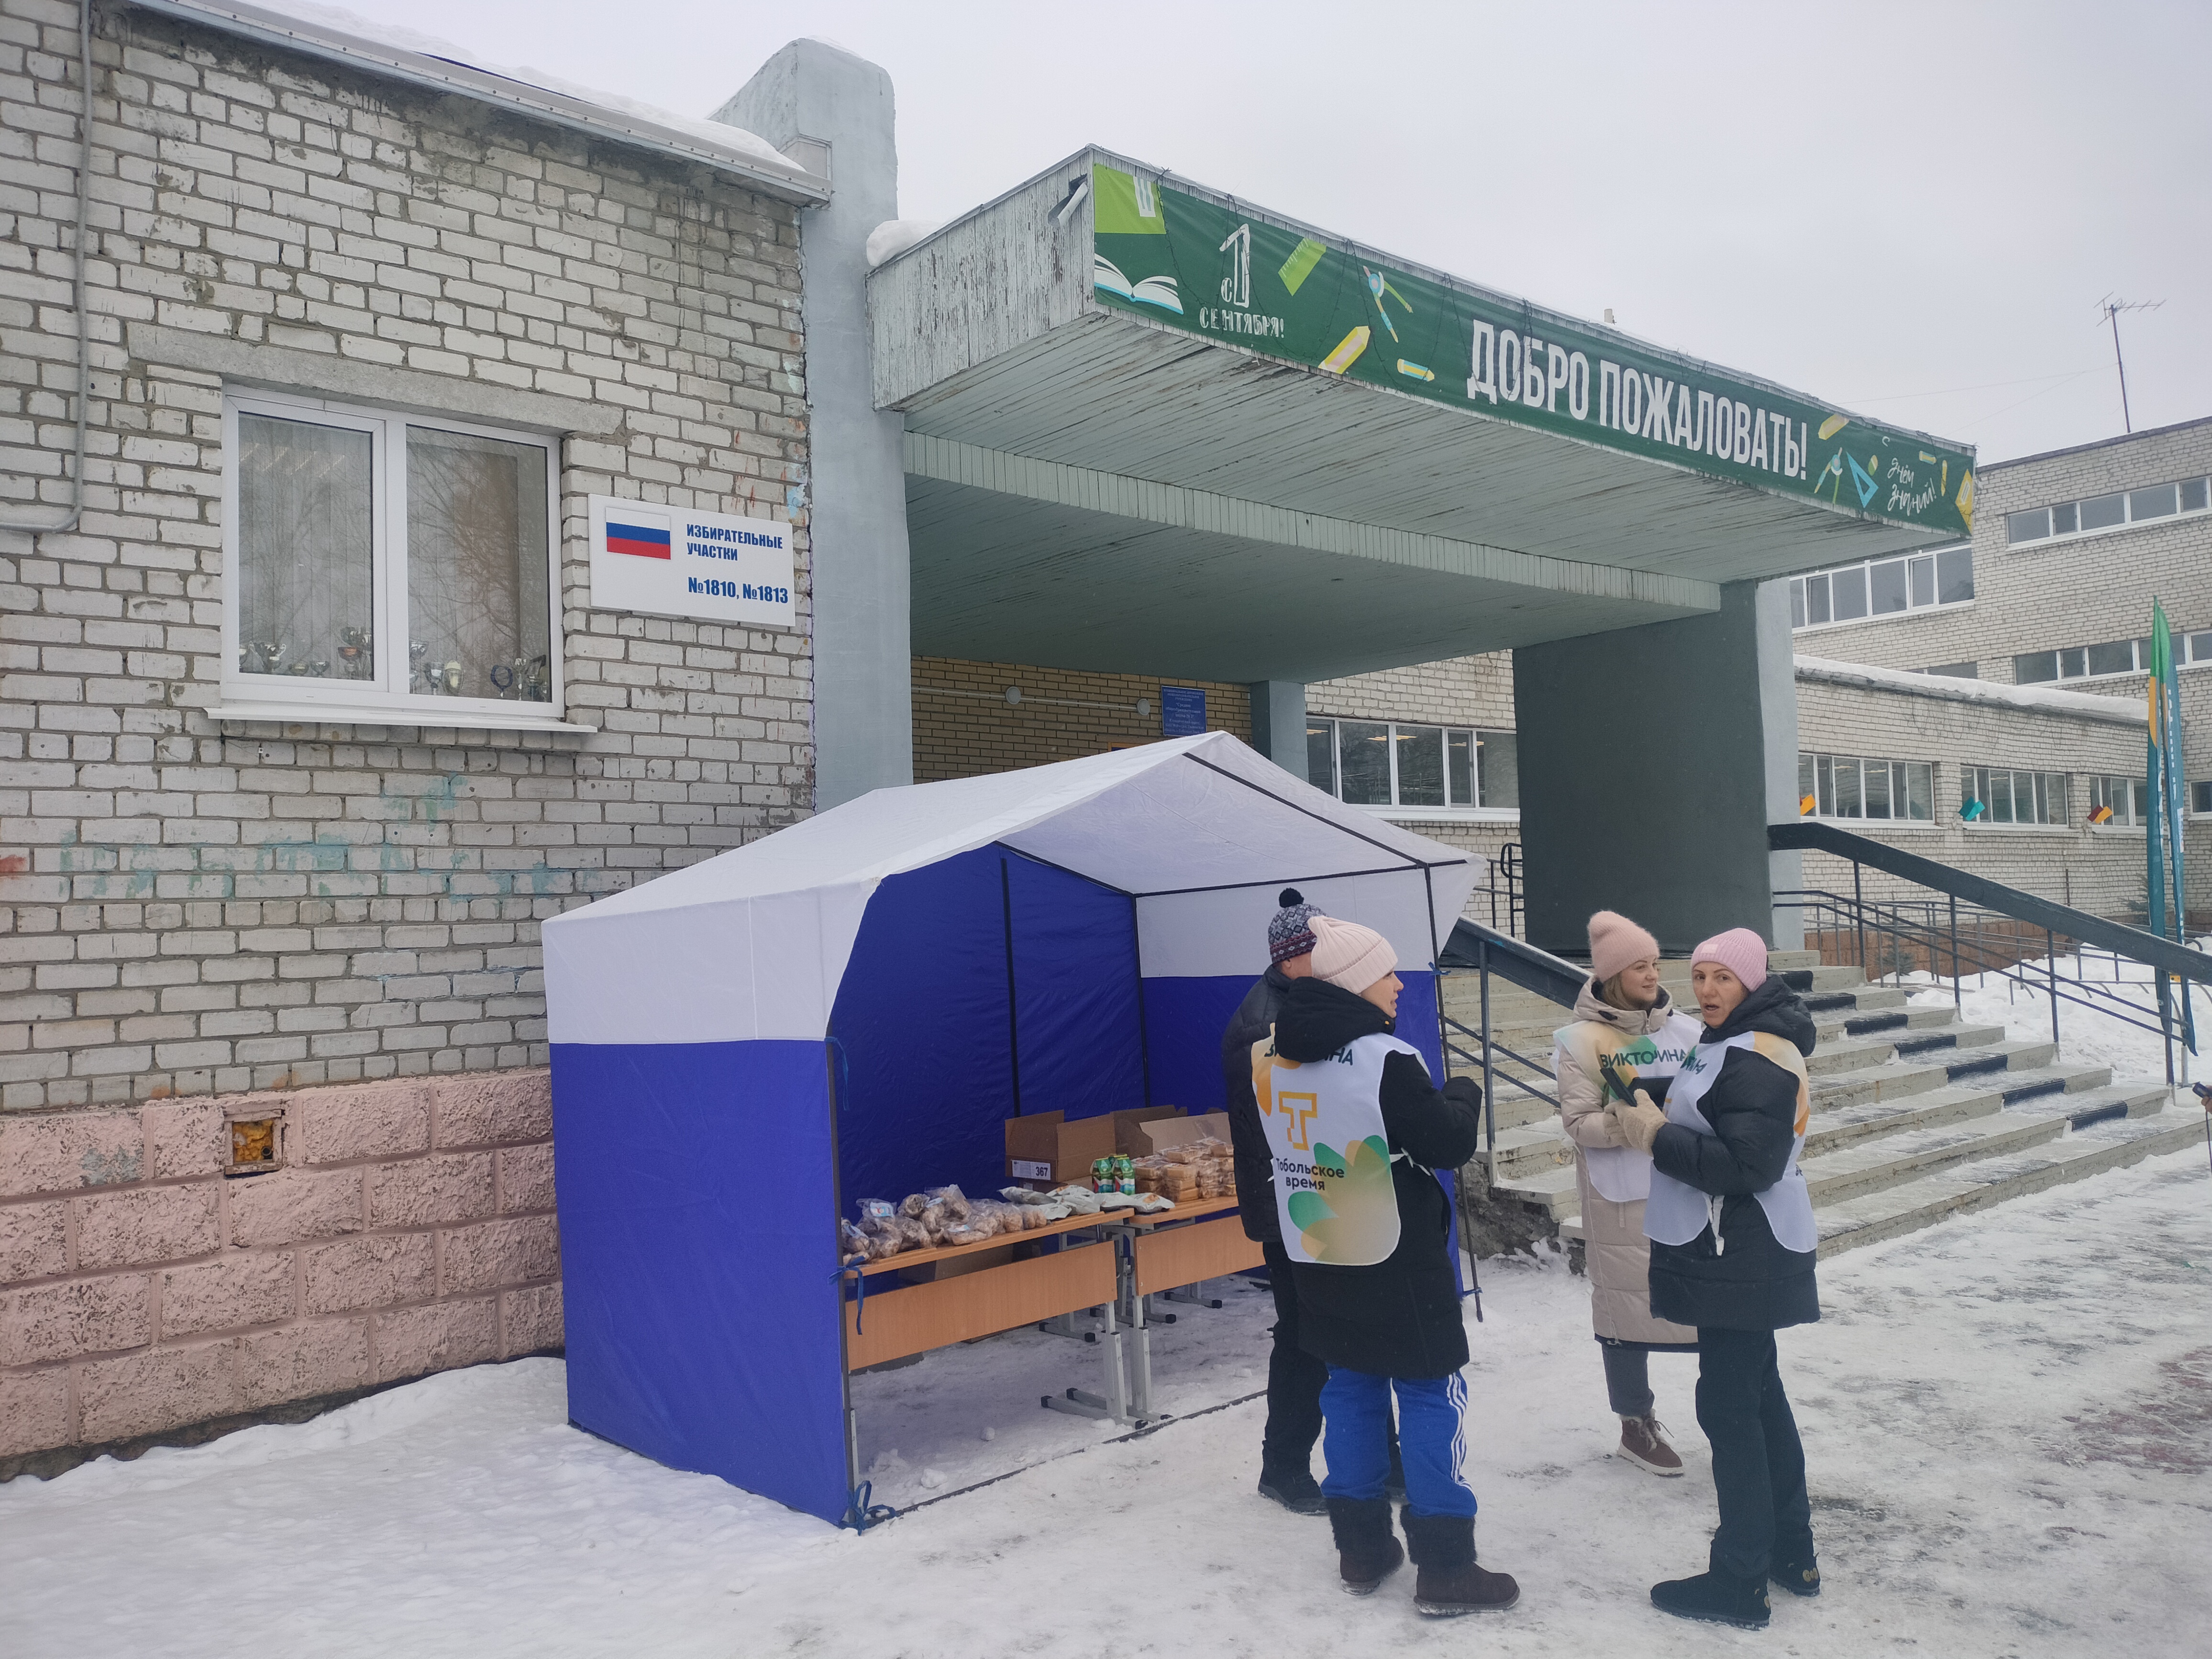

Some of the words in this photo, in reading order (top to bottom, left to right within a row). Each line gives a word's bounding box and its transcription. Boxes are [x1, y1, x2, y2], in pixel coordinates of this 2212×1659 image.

[1219, 223, 1250, 309] 1
[1199, 306, 1285, 339] СЕНТЯБРЯ!
[1466, 319, 1590, 421] ДОБРО
[1599, 359, 1807, 481] ПОЖАЛОВАТЬ!
[686, 524, 783, 549] ИЗБИРАТЕЛЬНЫЕ
[687, 542, 738, 561] УЧАСТКИ
[688, 577, 740, 600] №1810,
[742, 583, 789, 604] №1813
[1035, 1166, 1048, 1177] 367
[1276, 1158, 1345, 1178] Тобольское
[1286, 1177, 1325, 1191] время
